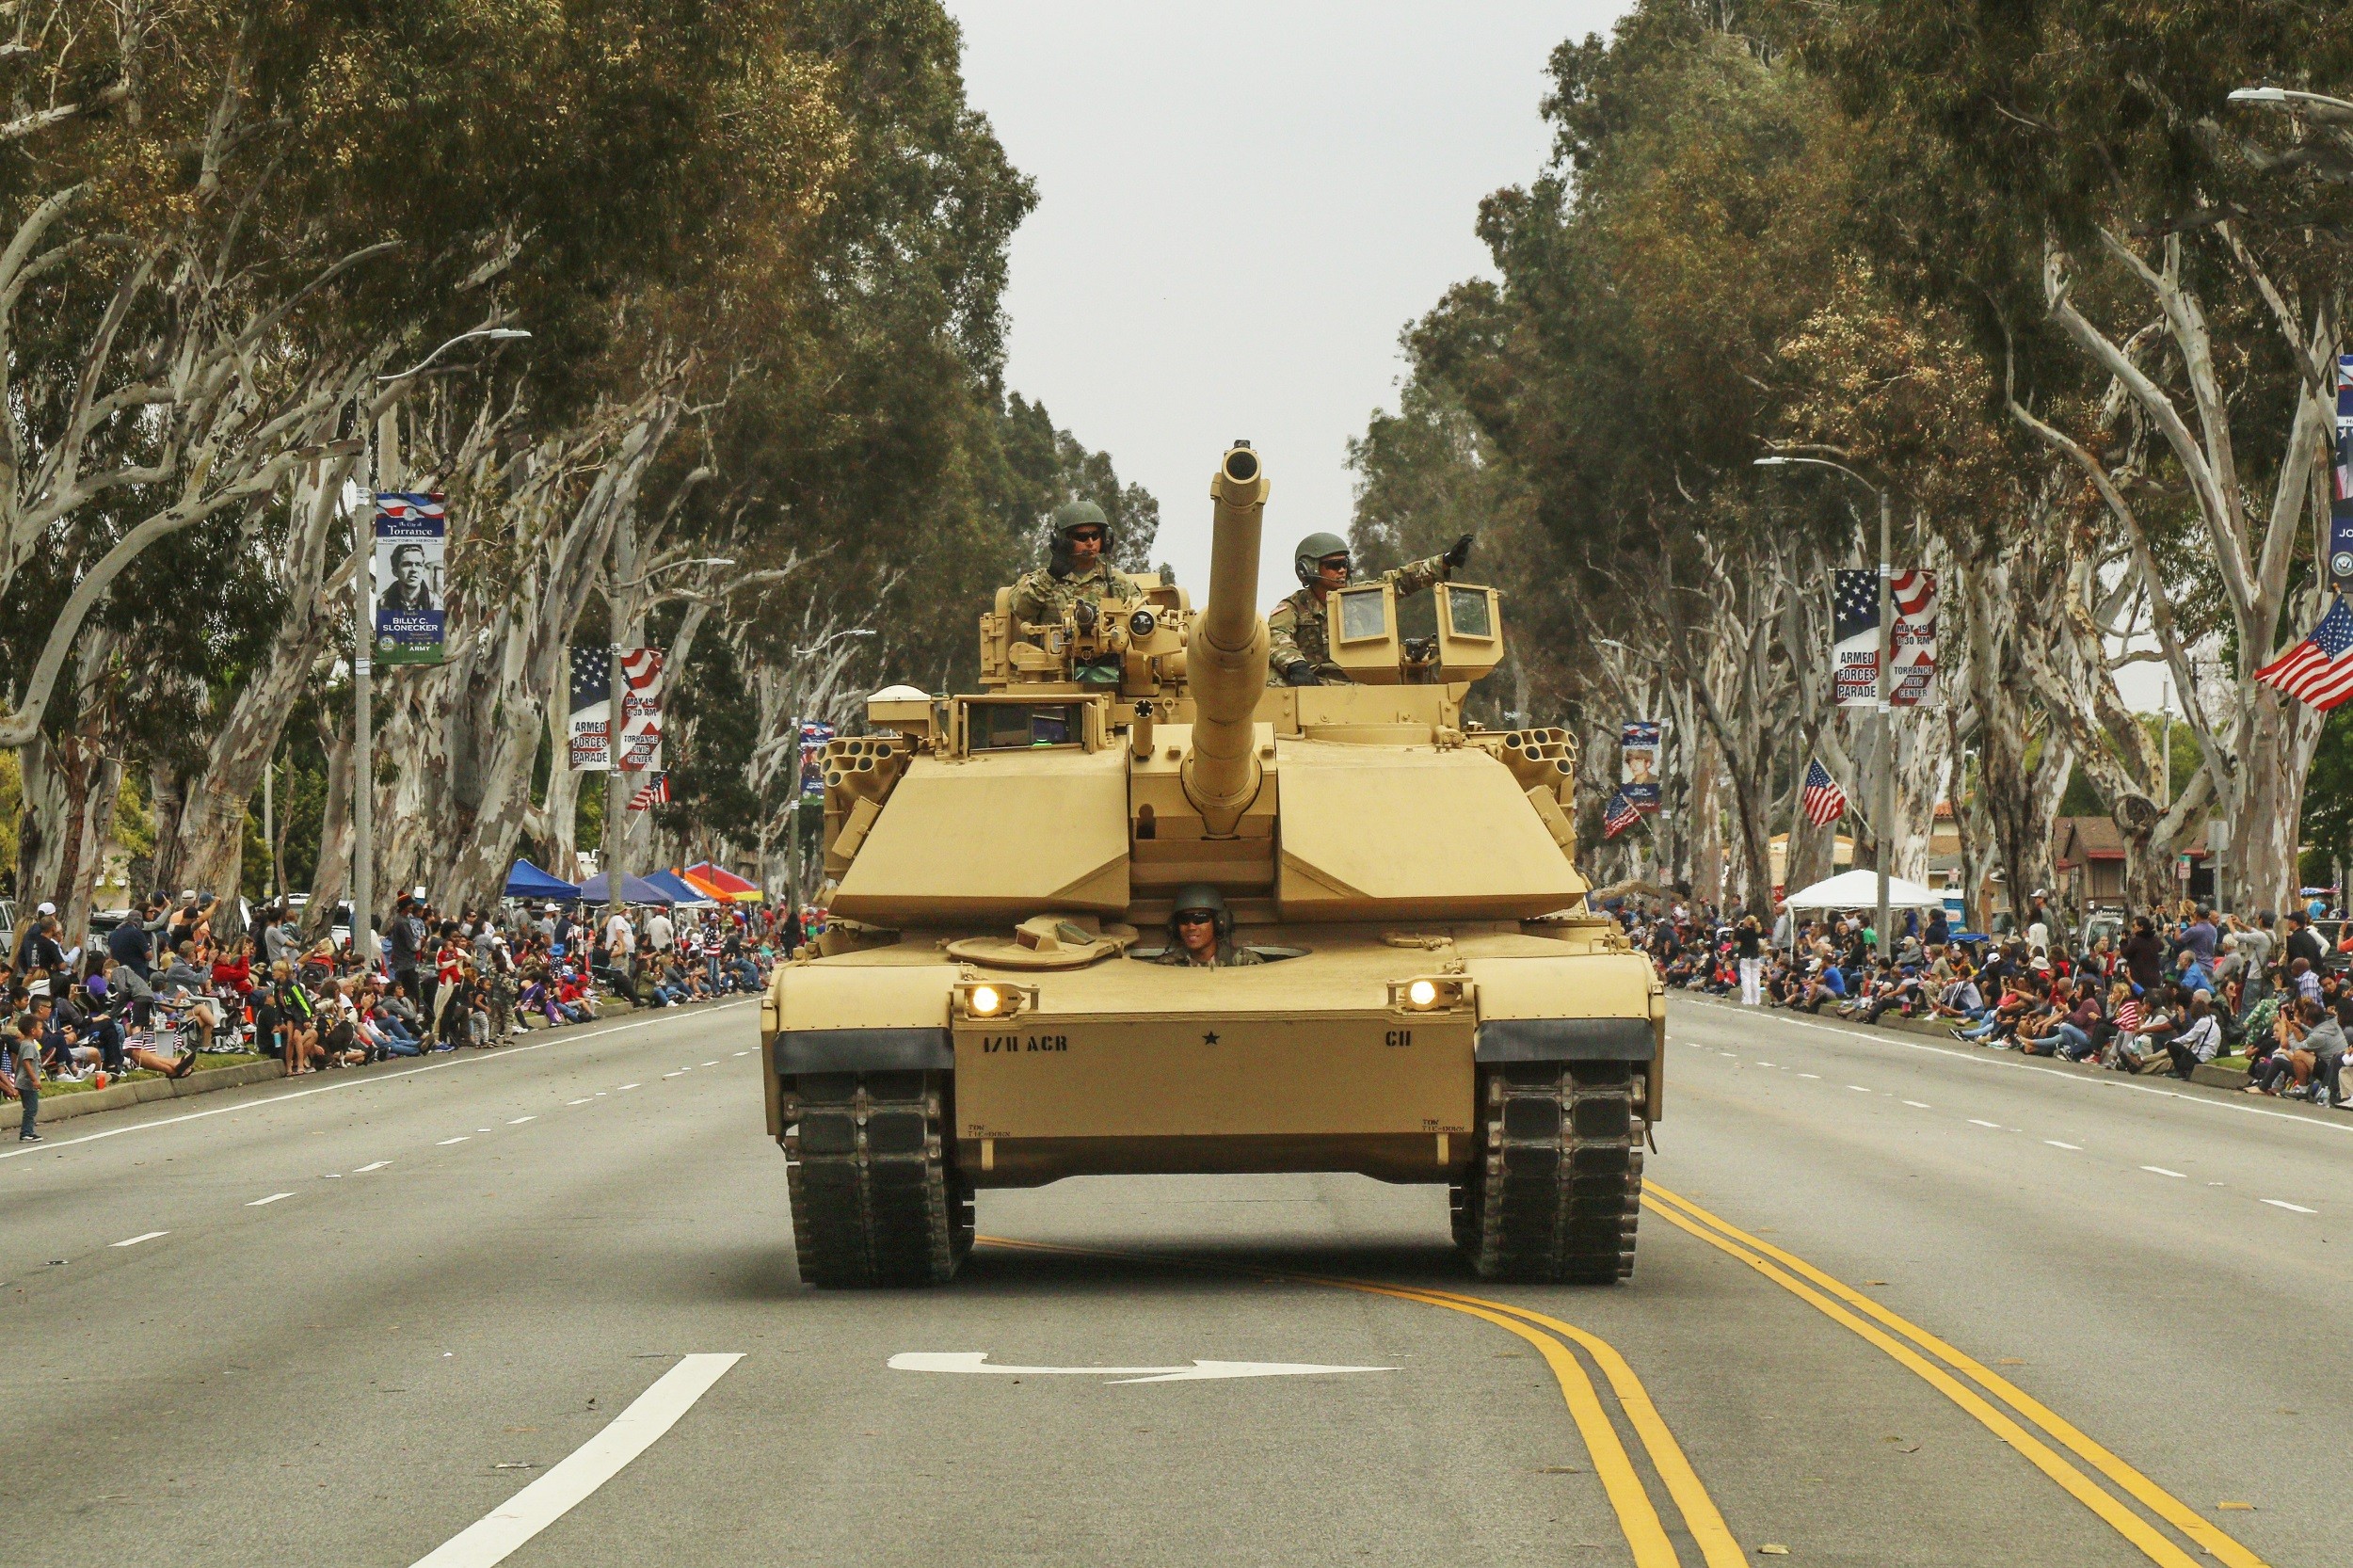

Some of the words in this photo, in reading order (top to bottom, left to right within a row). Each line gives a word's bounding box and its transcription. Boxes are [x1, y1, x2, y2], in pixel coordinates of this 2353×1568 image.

[387, 524, 433, 536] Torrance
[1897, 624, 1914, 632] MAY
[1918, 624, 1928, 632] 19
[1897, 636, 1914, 645] 1:30
[1917, 636, 1930, 645] PM
[1840, 651, 1874, 664] ARMED
[1838, 668, 1876, 680] FORCES
[1894, 666, 1932, 675] TORRANCE
[1904, 678, 1923, 686] CIVIC
[1838, 685, 1876, 697] PARADE
[1899, 689, 1928, 697] CENTER
[575, 721, 605, 733] ARMED
[573, 736, 607, 747] FORCES
[573, 752, 607, 762] PARADE
[1027, 1035, 1067, 1051] ACR
